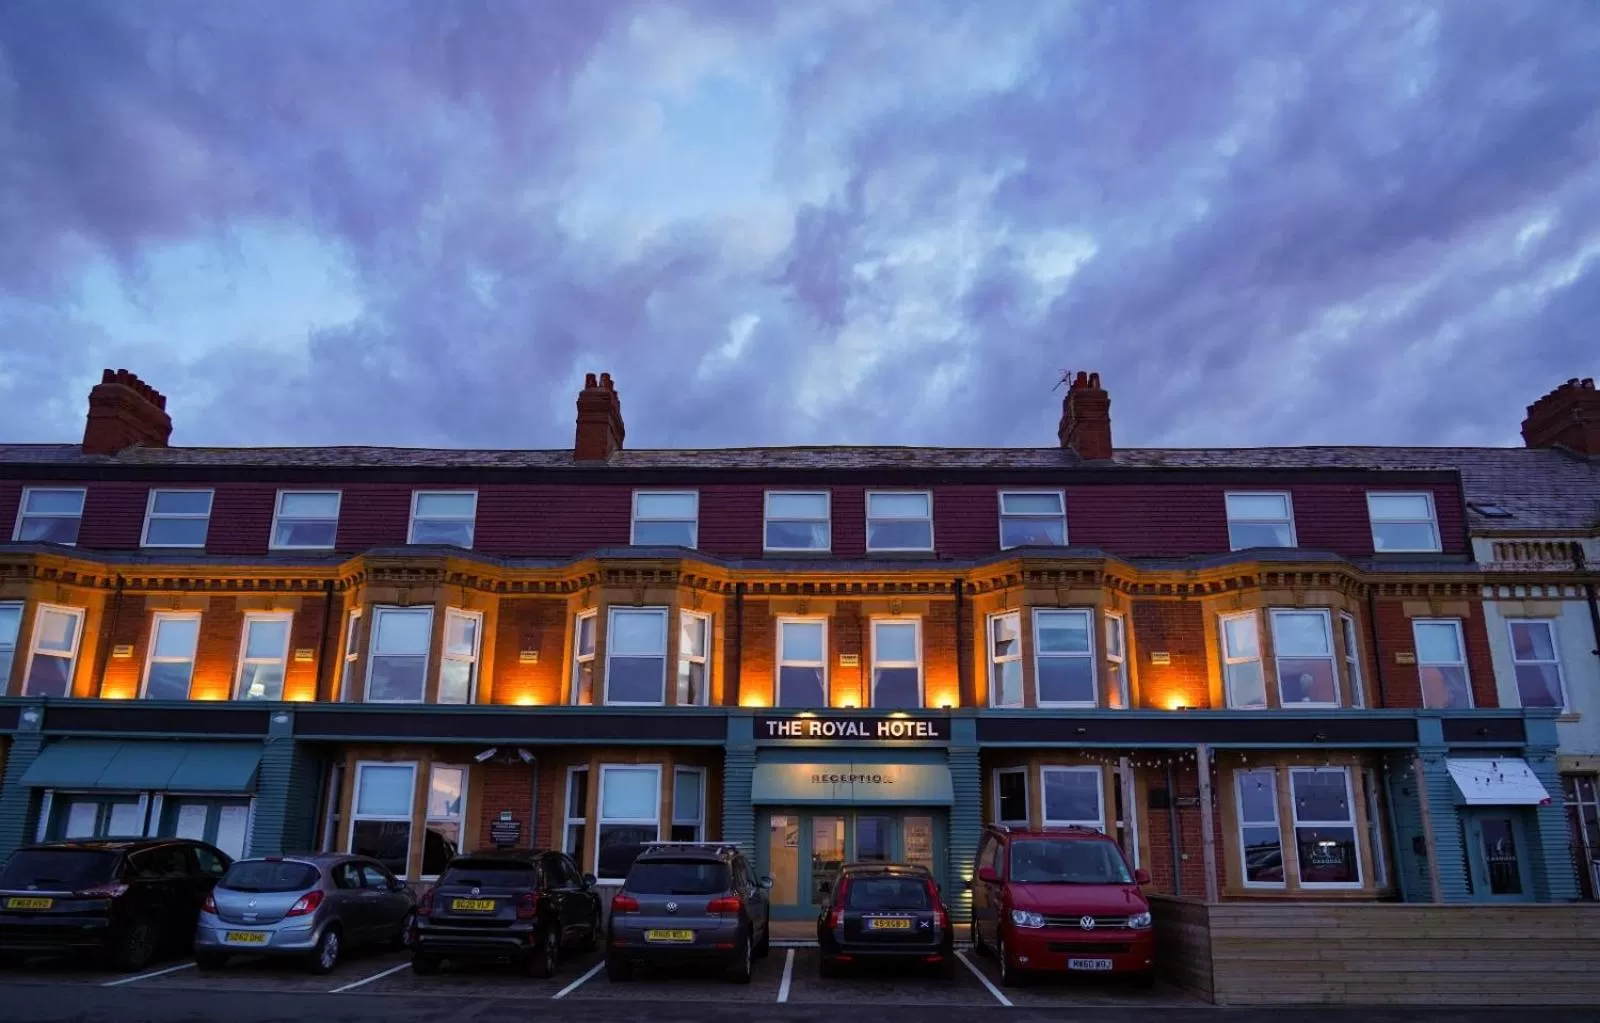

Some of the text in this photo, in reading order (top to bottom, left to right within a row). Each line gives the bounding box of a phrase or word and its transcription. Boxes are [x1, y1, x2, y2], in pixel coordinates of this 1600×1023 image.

[766, 721, 939, 737] THE ROYAL HOTEL
